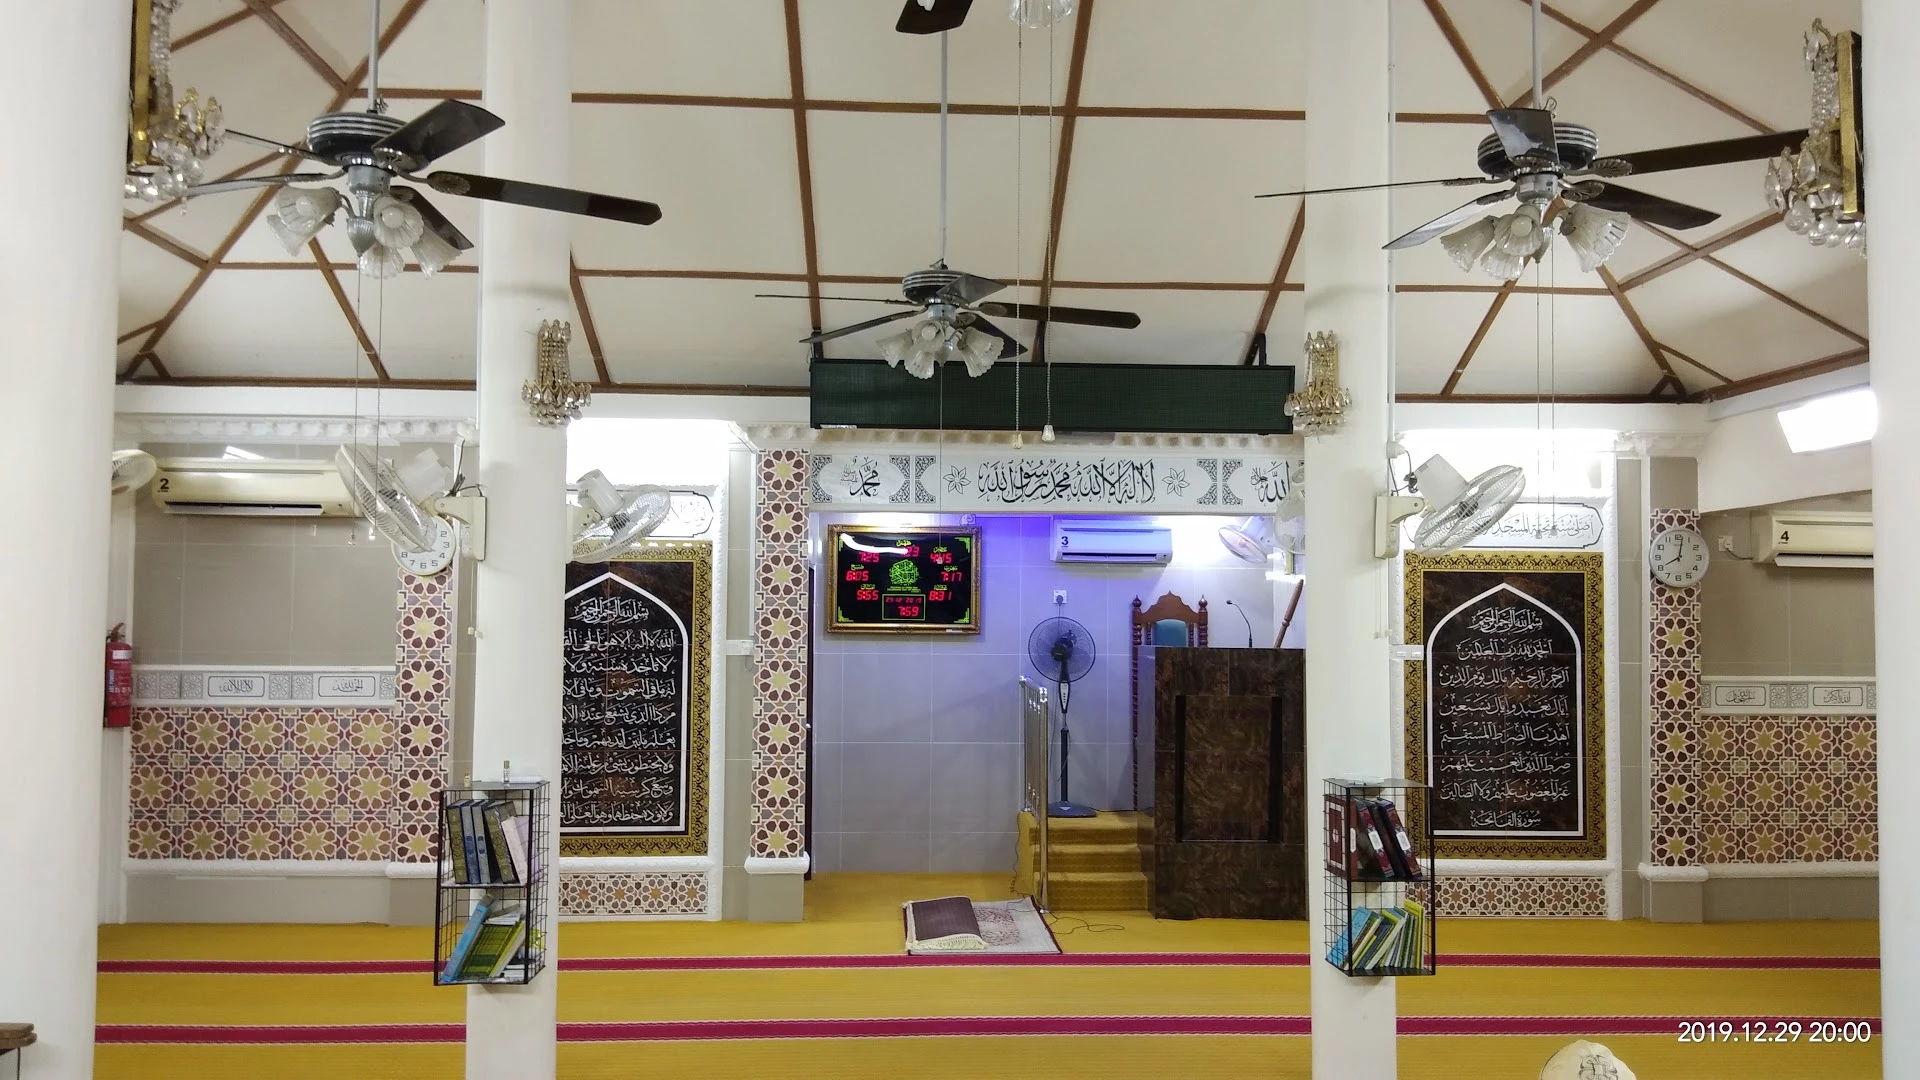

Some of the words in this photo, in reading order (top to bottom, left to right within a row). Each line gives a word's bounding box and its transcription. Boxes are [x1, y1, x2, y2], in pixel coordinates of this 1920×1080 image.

[160, 478, 169, 489] 2
[1061, 536, 1069, 546] 3
[1781, 530, 1790, 542] 4
[859, 551, 880, 562] 7:25
[846, 570, 869, 581] 6:05
[941, 571, 962, 582] 7:17
[857, 590, 879, 600] 5:55
[929, 590, 952, 601] 8:31
[898, 606, 919, 617] 7:59
